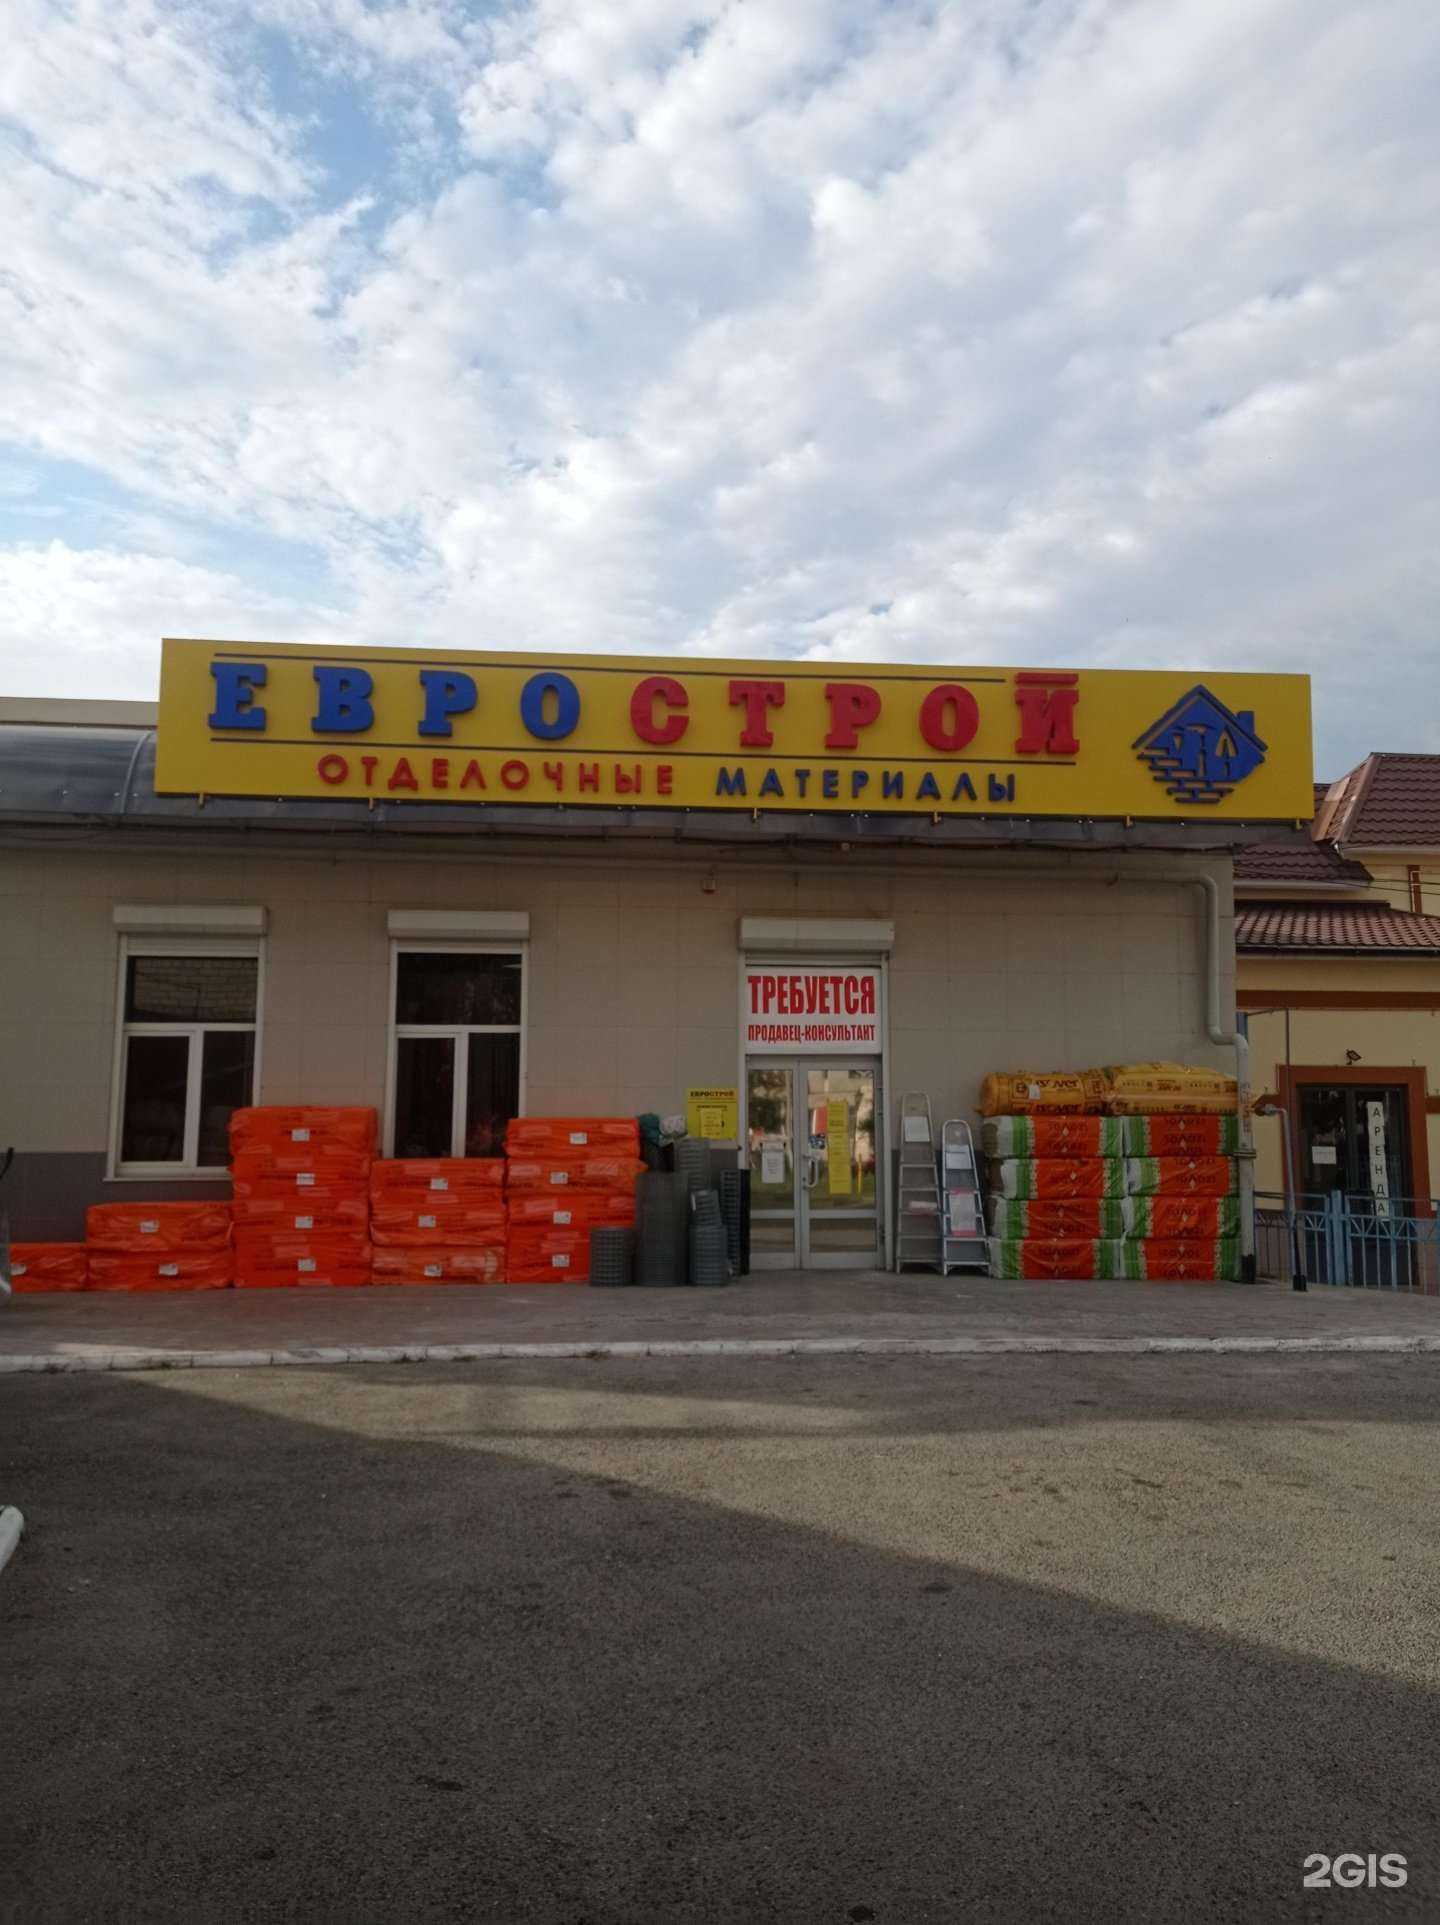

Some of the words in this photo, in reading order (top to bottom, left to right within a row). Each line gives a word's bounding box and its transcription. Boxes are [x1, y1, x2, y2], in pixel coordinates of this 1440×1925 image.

[208, 661, 1080, 755] ЕВРОСТРОЙ
[317, 753, 674, 795] ОТДЕЛОЧНЫЕ
[715, 765, 1016, 802] МАТЕРИАЛЫ
[747, 975, 875, 1015] ТРЕБУЕТСЯ
[748, 1024, 876, 1043] ПРОДАВЕЦ-КОНСУЛЬТАНТ
[1373, 1107, 1386, 1212] АРЕНДА
